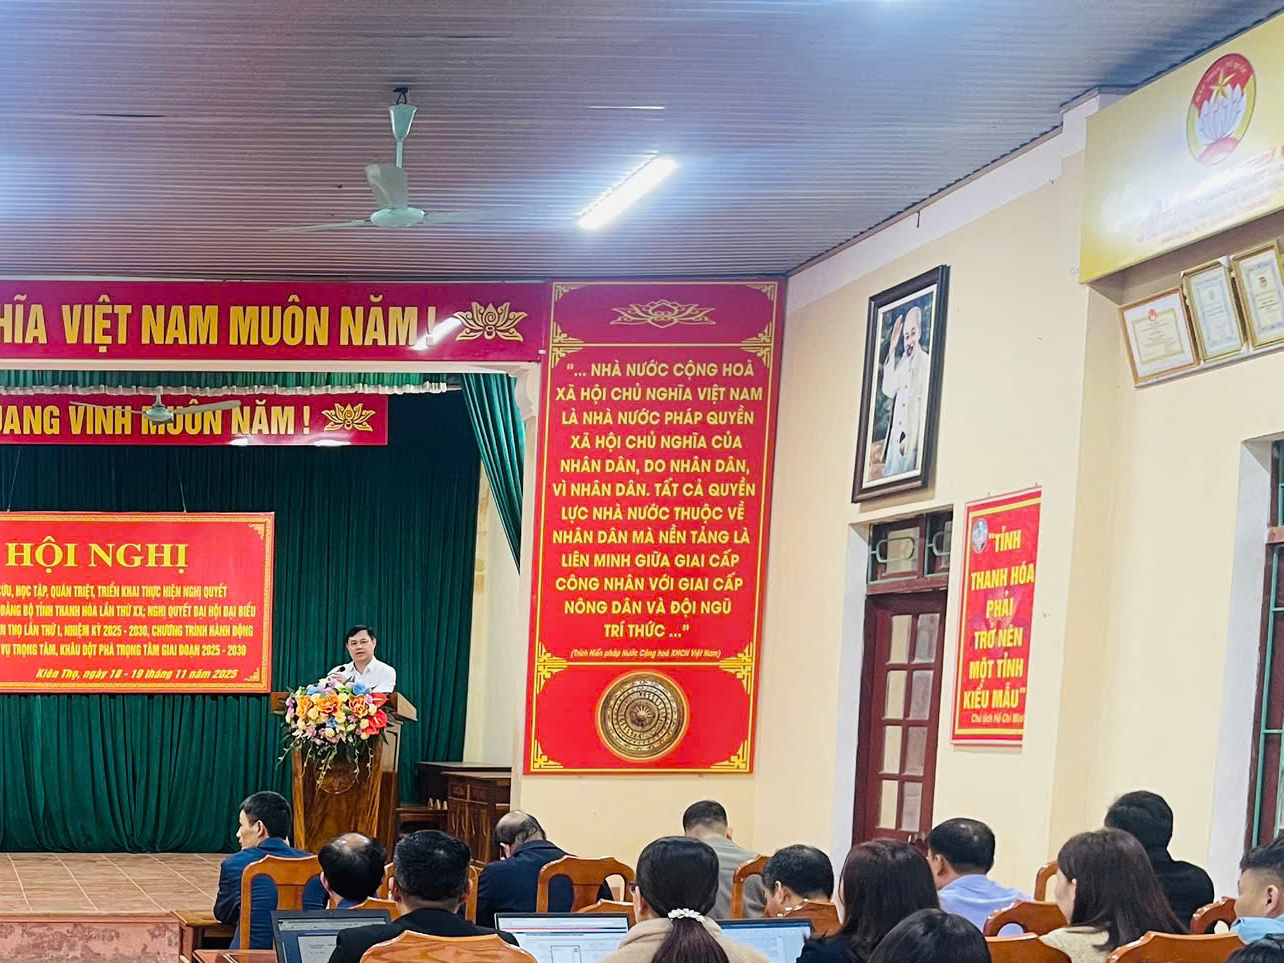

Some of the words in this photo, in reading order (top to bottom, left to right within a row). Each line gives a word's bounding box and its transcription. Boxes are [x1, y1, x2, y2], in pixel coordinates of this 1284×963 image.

[61, 294, 132, 353] VIỆT
[141, 305, 219, 345] NAM
[229, 294, 329, 346] MUÔN
[339, 294, 418, 346] NĂM
[555, 384, 576, 400] XÃ
[580, 384, 606, 404] HỘI
[611, 382, 642, 400] CHỦ
[646, 384, 692, 400] NGHĨA
[698, 384, 726, 404] VIỆT
[730, 387, 762, 400] NAM
[68, 405, 132, 435] VINH
[230, 399, 295, 435] NĂM
[561, 407, 579, 424] LÀ
[582, 408, 614, 424] NHÀ
[617, 408, 660, 424] NƯỚC
[664, 408, 703, 424] PHÁP
[706, 404, 754, 424] QUYỀN
[571, 432, 590, 448] XÃ
[596, 432, 620, 452] HỘI
[626, 430, 656, 448] CHỦ
[661, 432, 706, 448] NGHĨA
[712, 431, 742, 448] CỦA
[561, 456, 600, 472] NHÂN
[645, 459, 665, 472] DO
[671, 456, 710, 472] NHÂN
[5, 535, 78, 573] HỘI
[89, 543, 188, 574] NGHỊ
[561, 550, 590, 567] LIÊN
[594, 553, 631, 567] MINH
[634, 551, 670, 567] GIỮA
[674, 554, 705, 567] GIAI
[709, 548, 740, 567] CẤP
[555, 574, 600, 590] CÔNG
[604, 574, 645, 590] NHÂN
[649, 574, 674, 590] VỚI
[678, 577, 709, 590] GIAI
[712, 572, 744, 590] CẤP
[971, 568, 1008, 591] THANH
[1010, 561, 1035, 585] HÓA
[121, 586, 140, 597] KHAI
[162, 584, 181, 600] HIỆN
[182, 586, 202, 600] NGHỊ
[203, 583, 228, 598] QUYẾT
[986, 590, 1014, 618] PHẢI
[974, 623, 996, 649] TRỞ
[997, 626, 1023, 648] NÊN
[161, 644, 177, 656] GIAI
[36, 668, 58, 678] Kiên
[82, 668, 107, 679] ngày
[175, 669, 186, 678] 11
[211, 669, 238, 678] 2025
[969, 657, 994, 682] MỘT
[997, 652, 1024, 678] TỈNH
[963, 683, 990, 709] KIỂU
